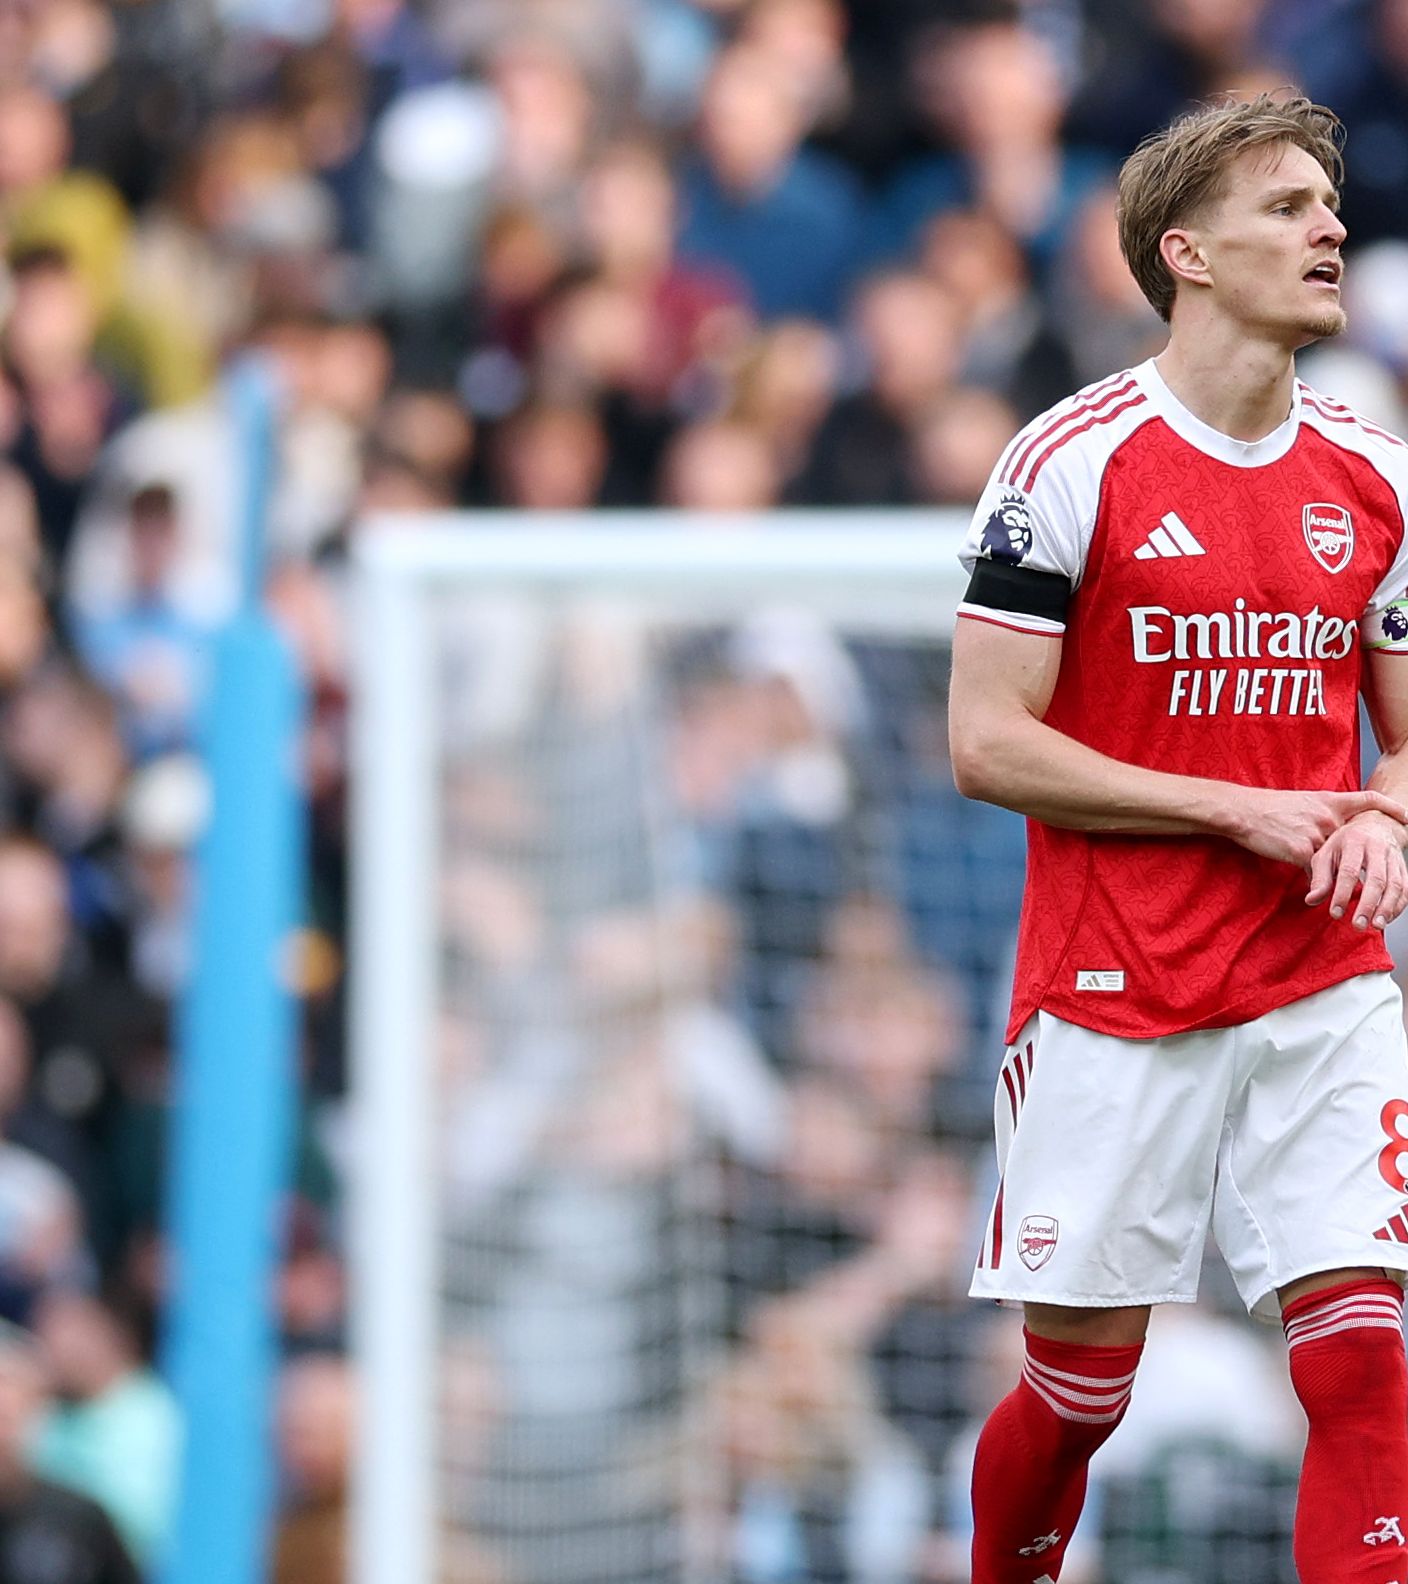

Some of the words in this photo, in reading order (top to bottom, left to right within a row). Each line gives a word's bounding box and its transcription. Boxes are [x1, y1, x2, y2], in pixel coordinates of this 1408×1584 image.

[1310, 513, 1346, 529] Arsenal
[1127, 597, 1358, 663] Emirates
[1168, 669, 1228, 716] FLY
[1022, 1224, 1053, 1235] Arsenal
